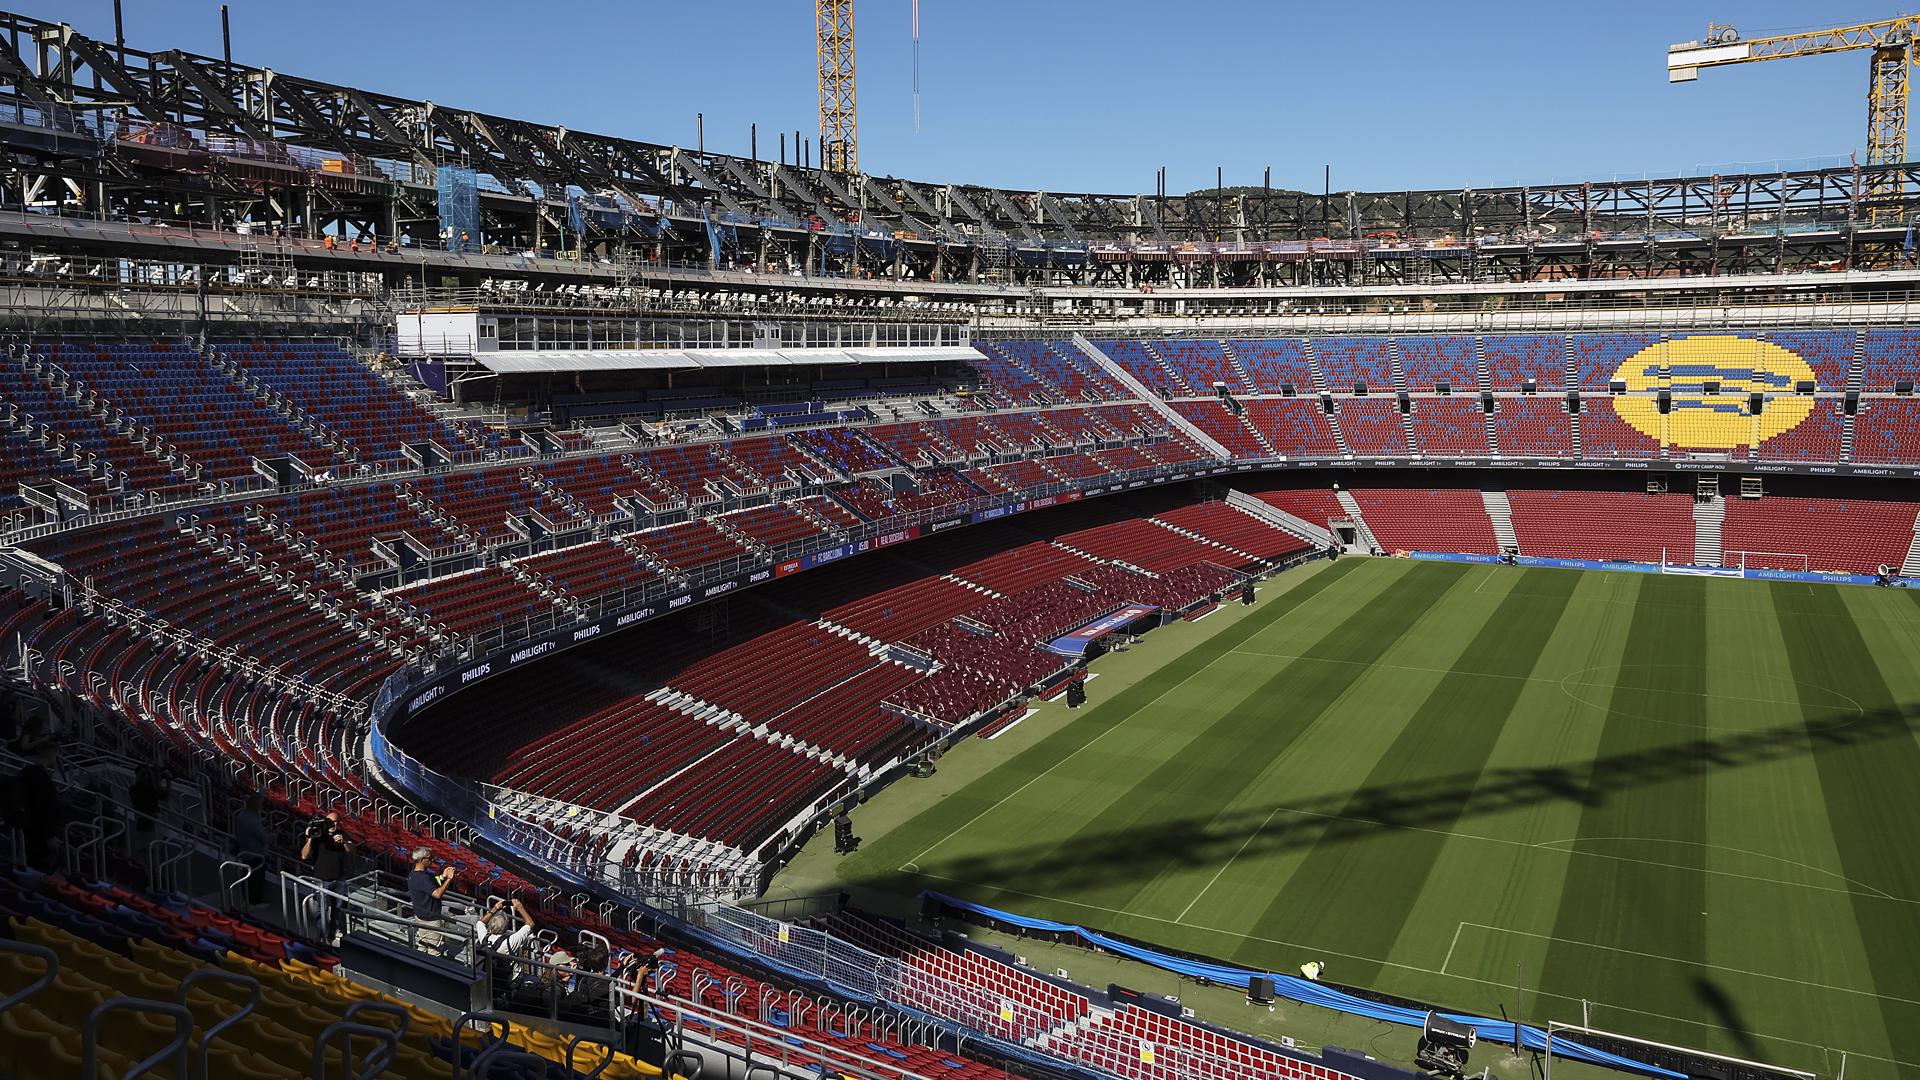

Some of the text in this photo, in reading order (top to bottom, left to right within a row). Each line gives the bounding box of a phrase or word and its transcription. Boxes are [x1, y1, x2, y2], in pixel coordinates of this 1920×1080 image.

[849, 544, 854, 554] 2
[750, 570, 769, 582] PHILIPS
[705, 582, 732, 597] AMBILIGHT
[669, 594, 692, 608] PHILIPS
[617, 608, 648, 626] AMBILIGHT
[574, 624, 600, 641] PHILIPS
[510, 641, 556, 664] AMBILIGHT tv
[462, 663, 490, 683] PHILIPS
[408, 686, 438, 713] AMBILIGHT
